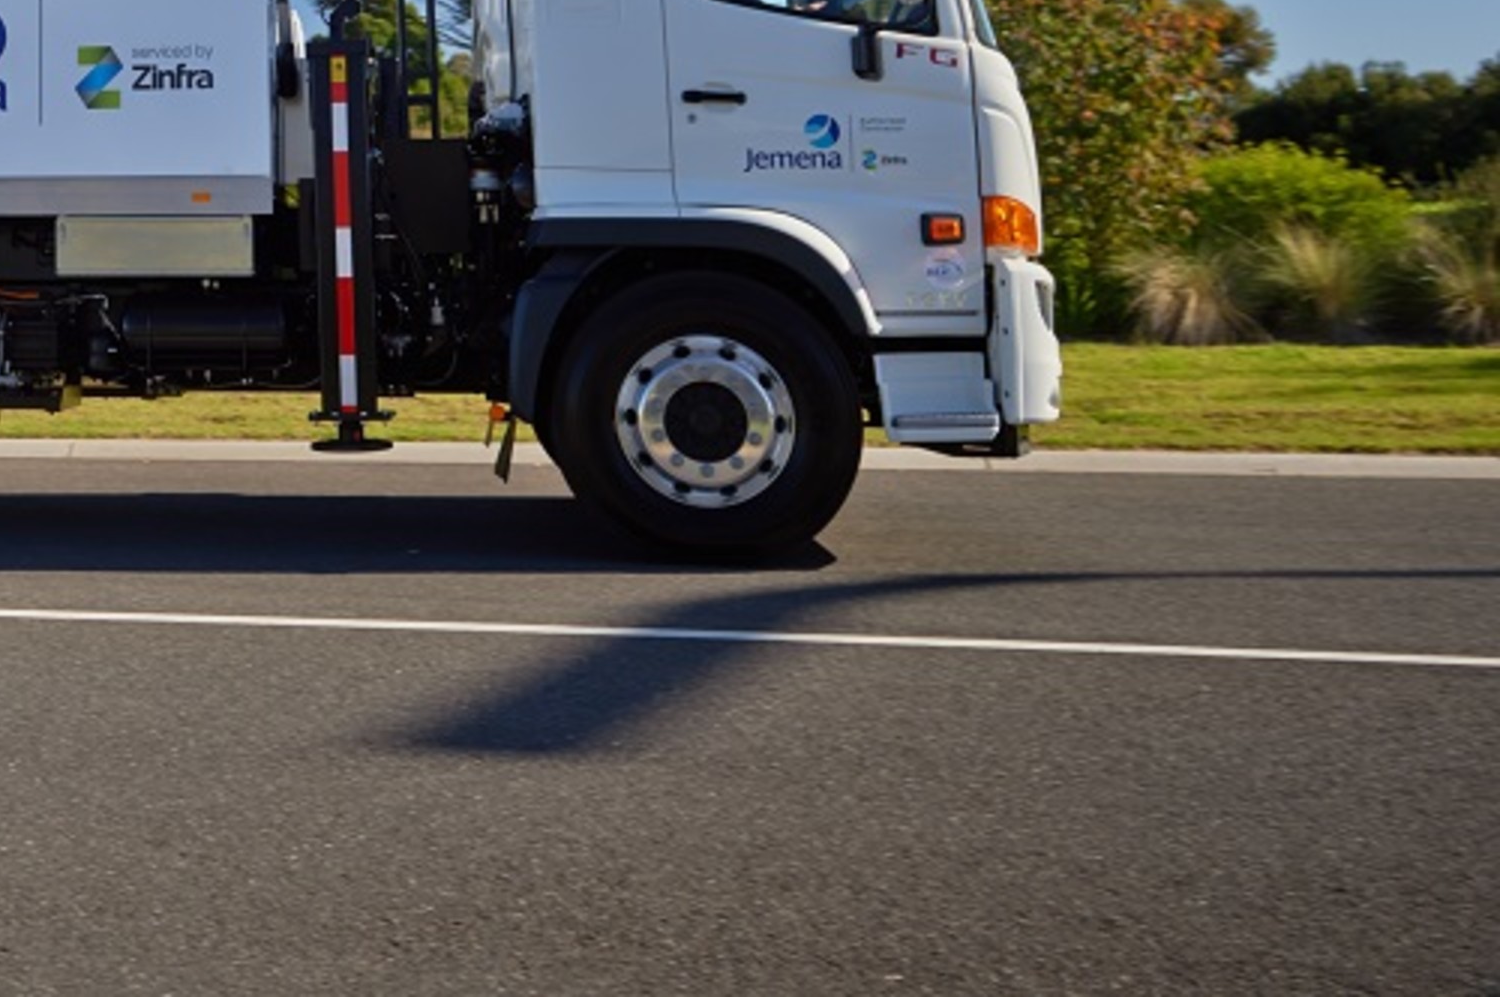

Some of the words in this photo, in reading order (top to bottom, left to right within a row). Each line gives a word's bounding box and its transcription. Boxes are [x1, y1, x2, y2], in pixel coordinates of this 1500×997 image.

[131, 44, 191, 60] serviced
[194, 43, 214, 61] by
[130, 63, 214, 91] Zinfra
[743, 147, 842, 173] Jemena
